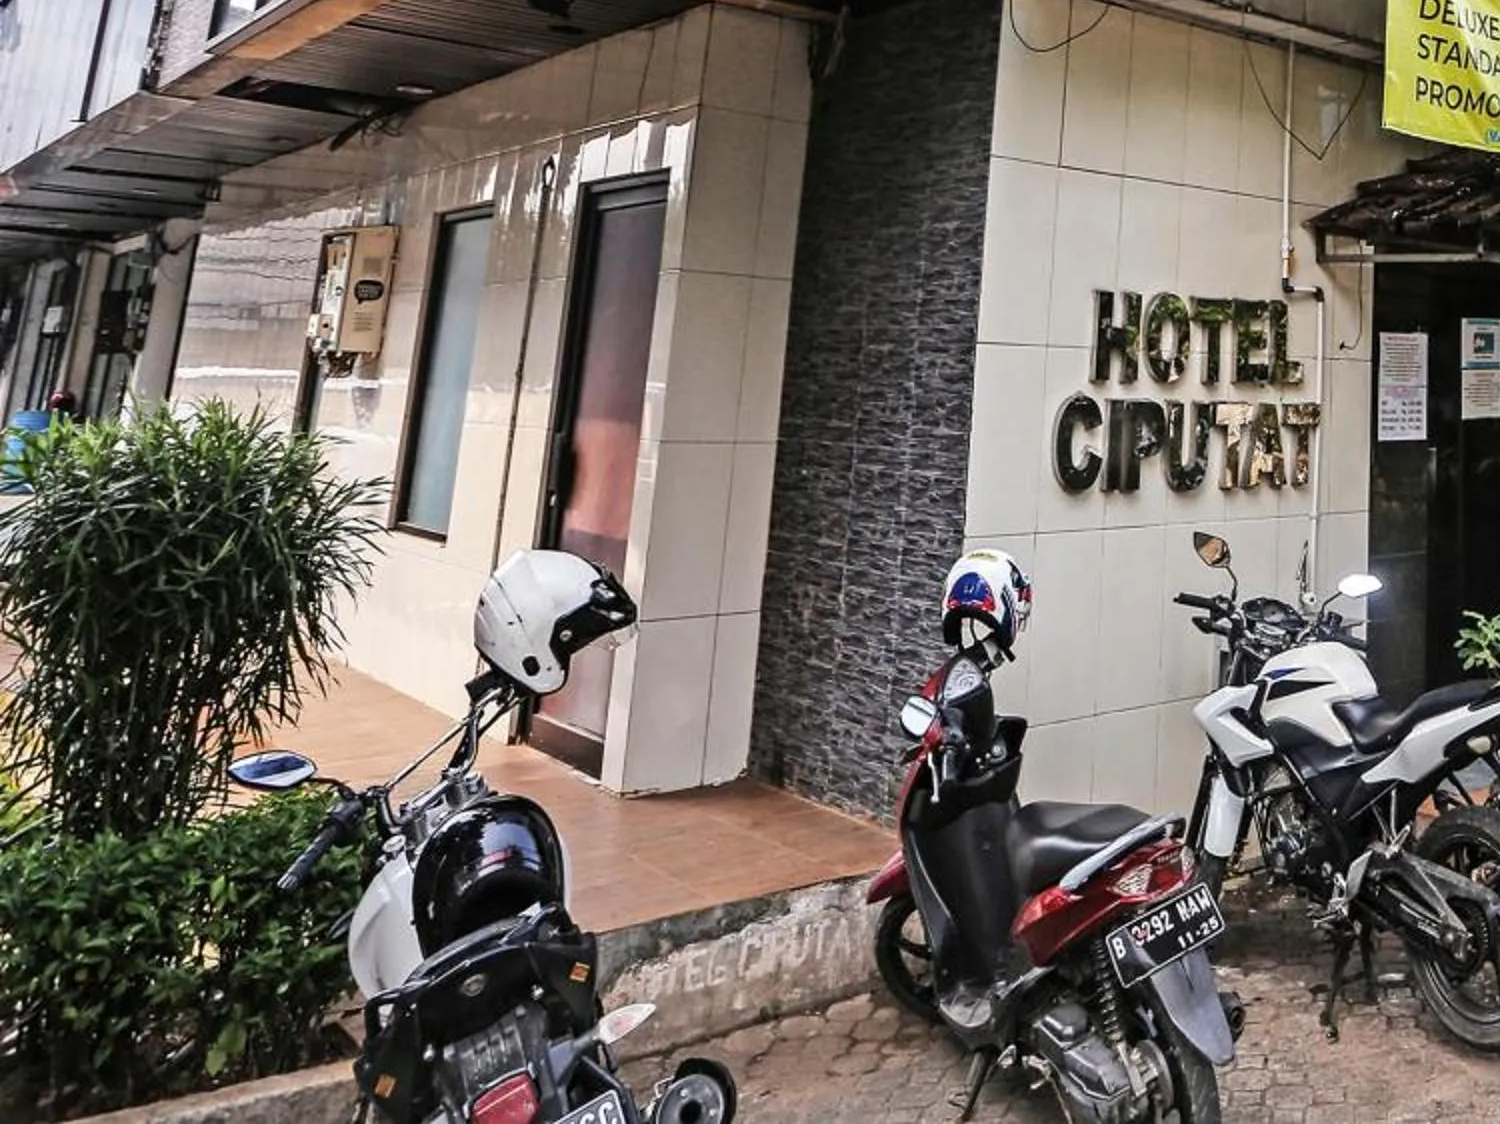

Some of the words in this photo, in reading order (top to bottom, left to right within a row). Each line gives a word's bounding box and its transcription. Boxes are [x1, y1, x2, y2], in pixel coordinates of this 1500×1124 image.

[1088, 288, 1304, 387] HOTEL
[1051, 390, 1321, 492] CIPUTAT
[1111, 936, 1127, 960] B
[1131, 909, 1175, 946] 3292
